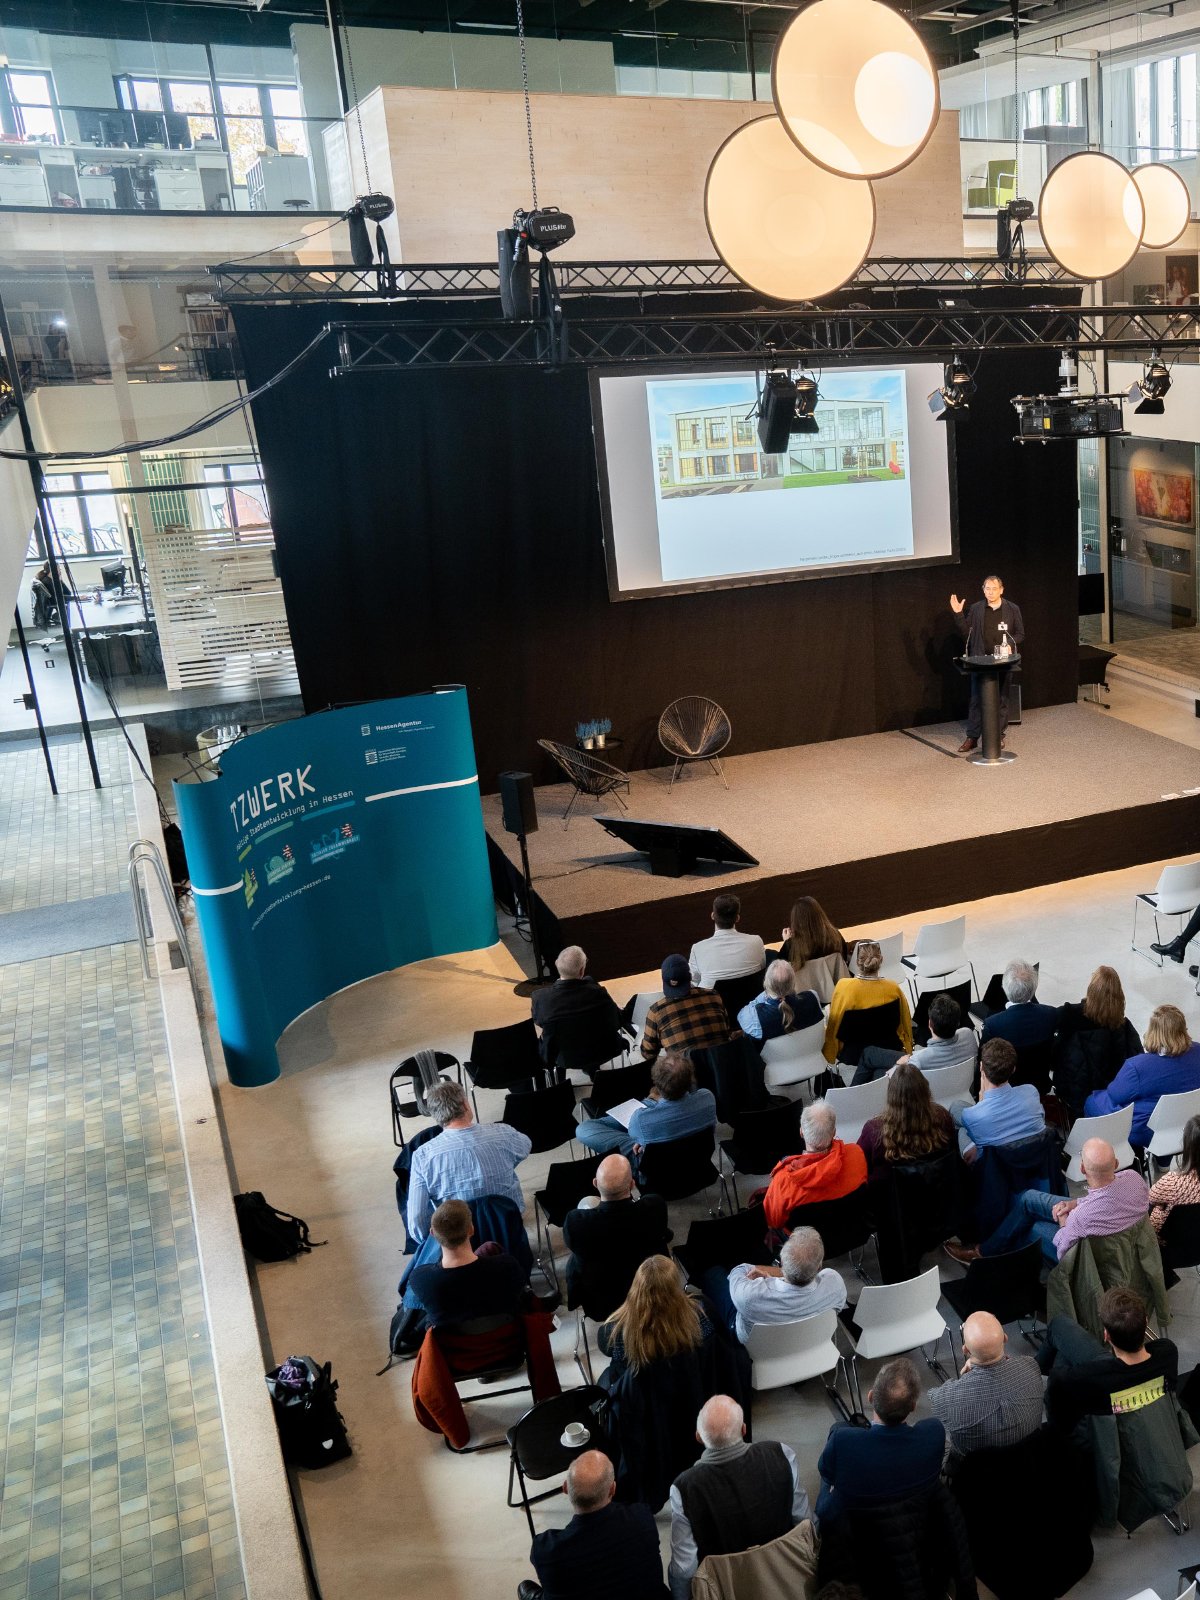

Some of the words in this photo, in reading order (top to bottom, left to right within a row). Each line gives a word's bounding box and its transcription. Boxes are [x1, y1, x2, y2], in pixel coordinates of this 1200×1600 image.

[249, 804, 306, 837] Stadtentwicklung
[309, 800, 318, 808] in
[322, 790, 354, 804] Hessen
